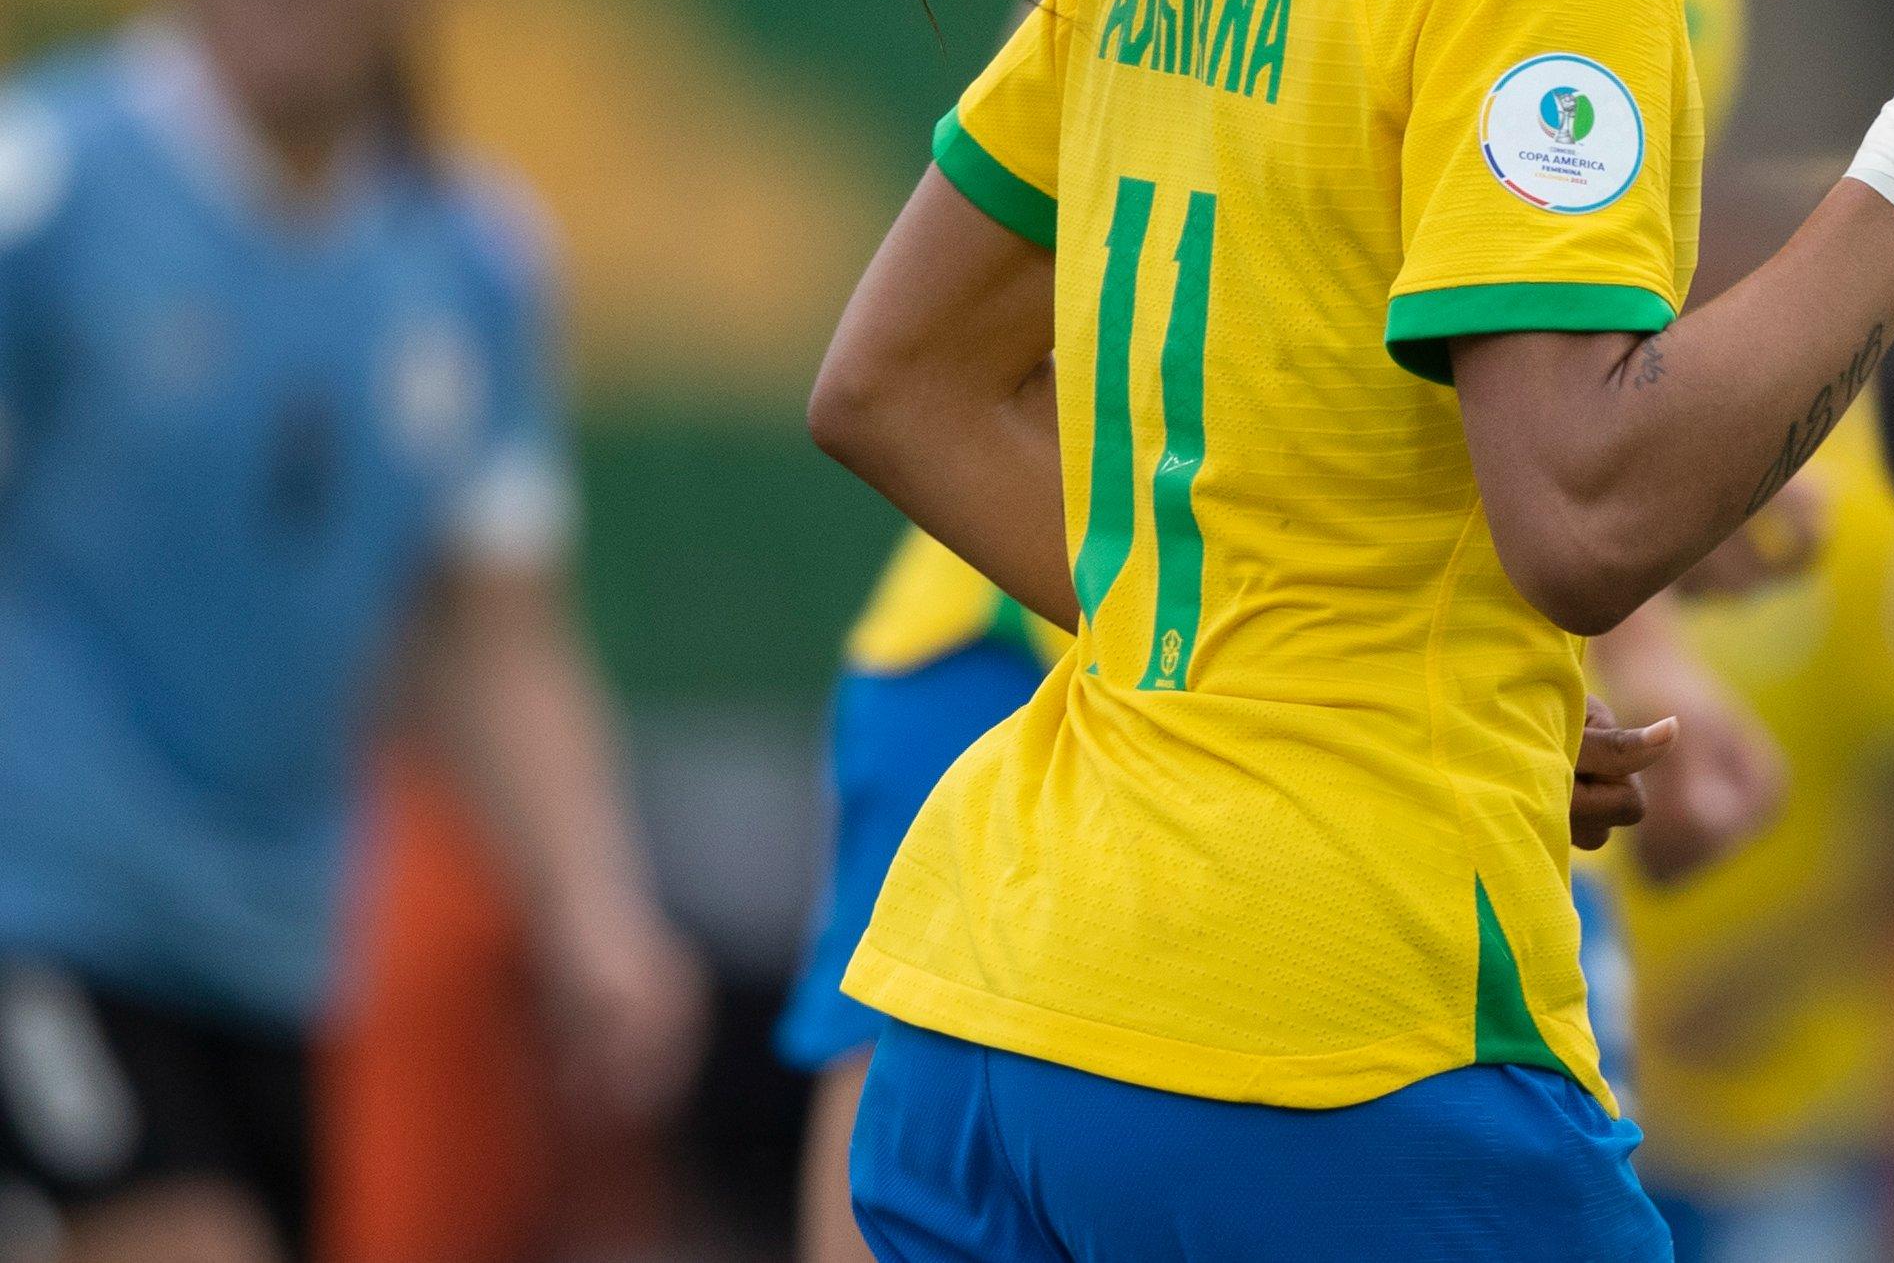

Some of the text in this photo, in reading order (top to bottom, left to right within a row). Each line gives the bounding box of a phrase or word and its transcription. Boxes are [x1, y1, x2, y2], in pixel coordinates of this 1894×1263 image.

[1518, 150, 1550, 163] COPA
[1553, 155, 1606, 172] AMERICA
[1542, 165, 1582, 177] FEMENINA
[1073, 174, 1218, 691] 11
